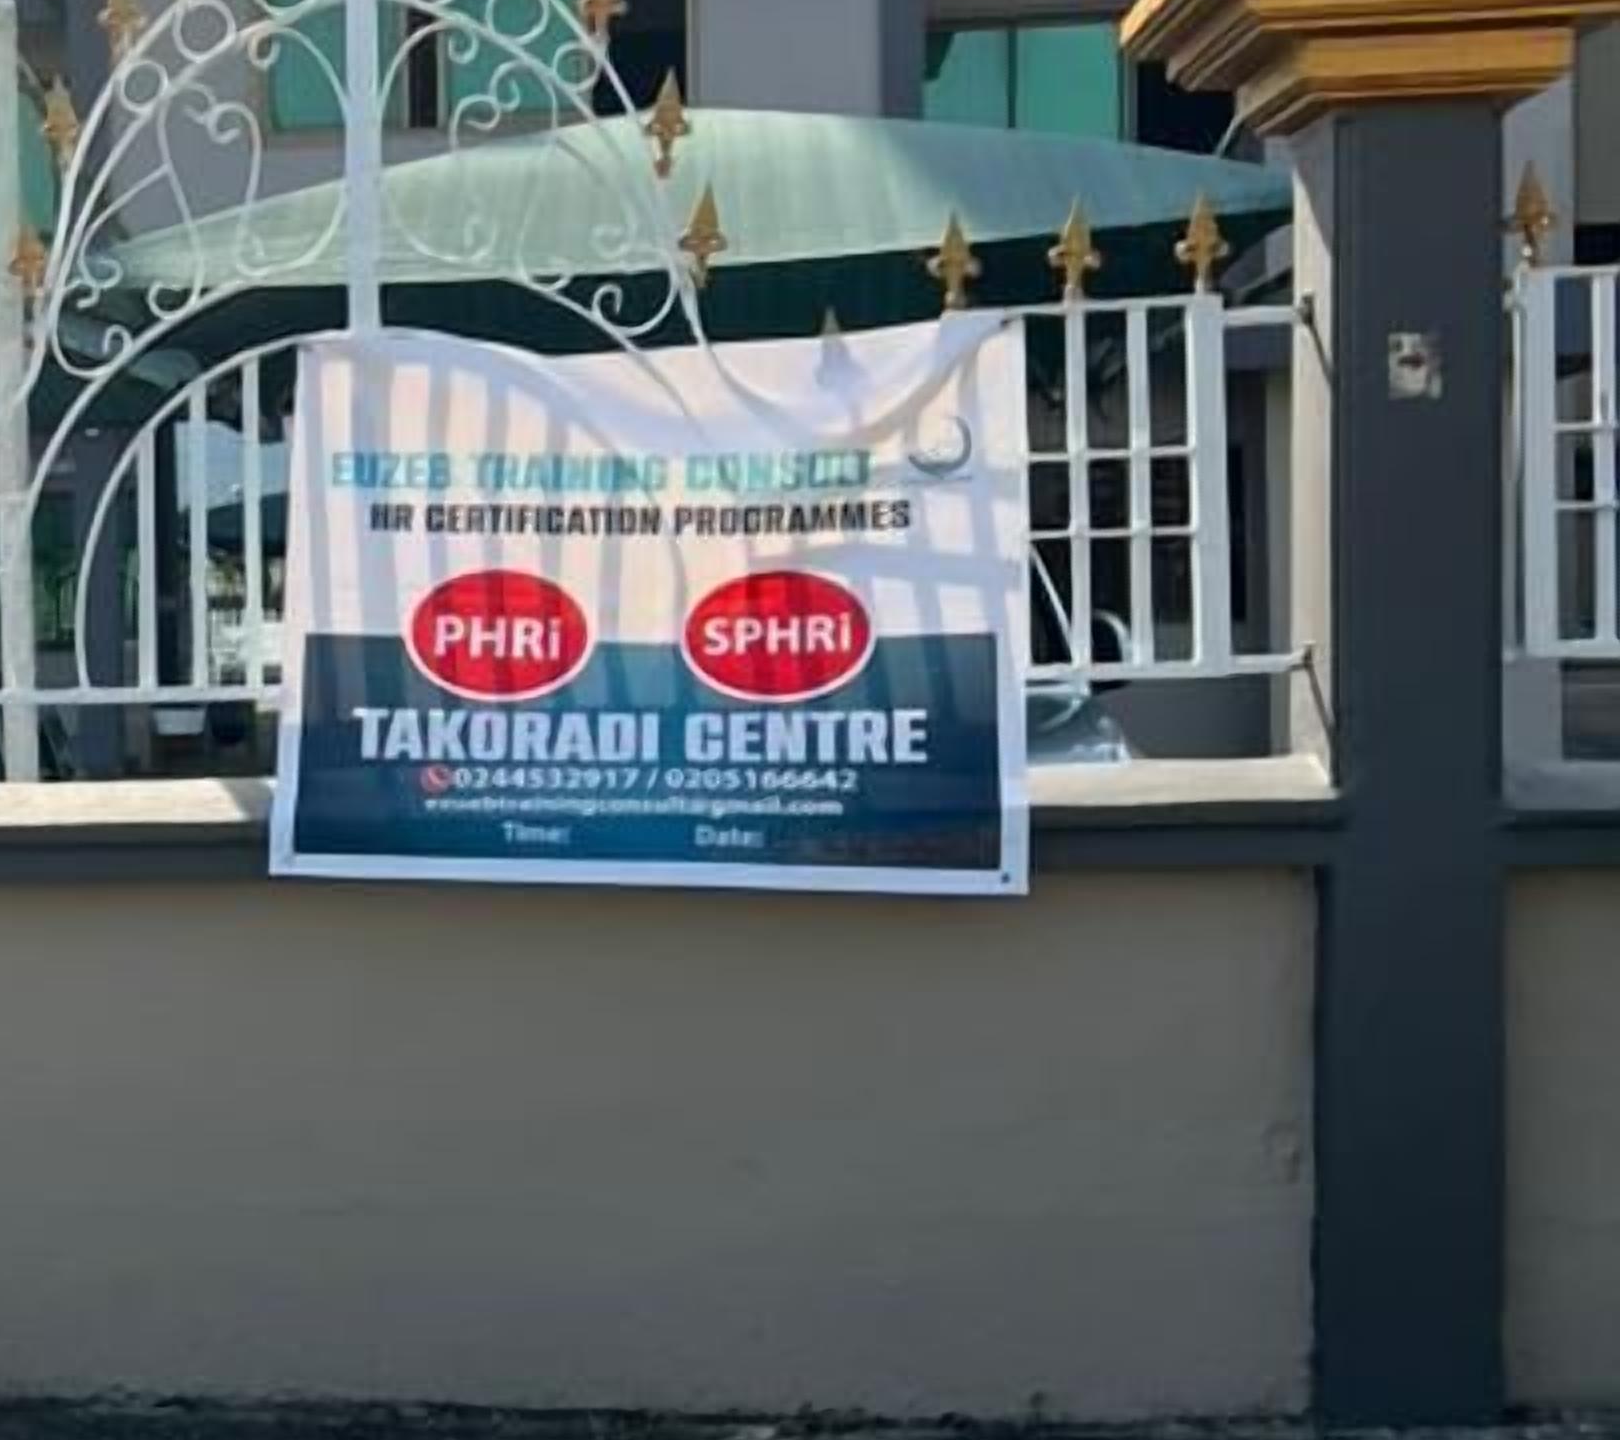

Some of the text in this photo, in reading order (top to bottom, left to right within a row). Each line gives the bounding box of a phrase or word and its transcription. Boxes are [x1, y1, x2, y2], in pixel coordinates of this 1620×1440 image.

[470, 452, 667, 492] TRAINING
[683, 449, 872, 491] CONSULT
[369, 500, 912, 537] HR CERTIFICATION PROGRAMMES
[353, 707, 928, 763] TAKORADI CENTRE
